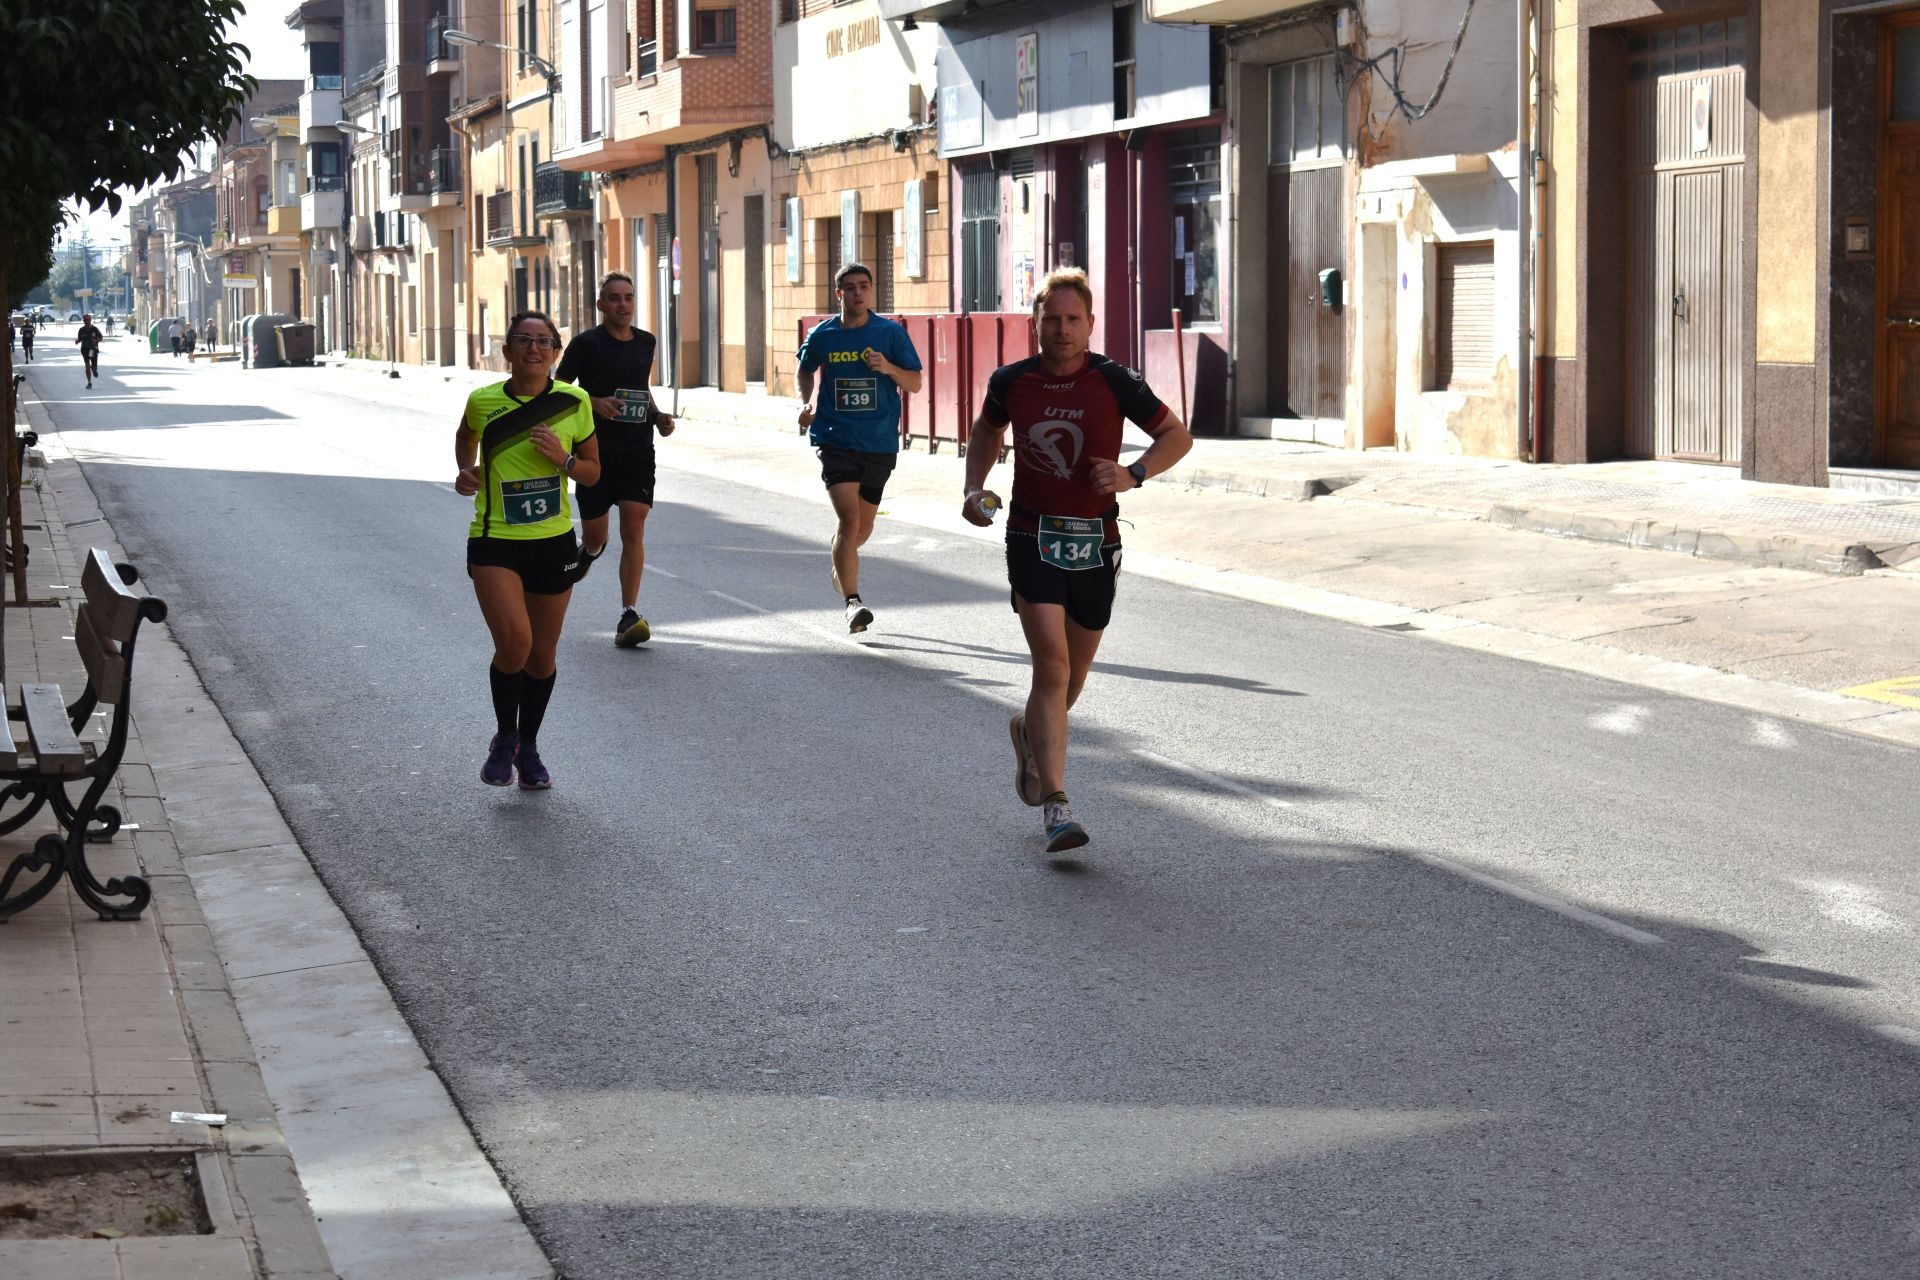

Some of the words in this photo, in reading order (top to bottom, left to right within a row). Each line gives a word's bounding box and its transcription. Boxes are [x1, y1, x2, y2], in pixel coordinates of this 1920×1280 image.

[826, 27, 844, 60] CINE
[847, 15, 881, 54] AVENIDA
[841, 393, 870, 406] 139
[620, 403, 645, 418] 110
[1043, 406, 1085, 419] UTM
[521, 498, 548, 517] 13
[1050, 540, 1093, 561] 134
